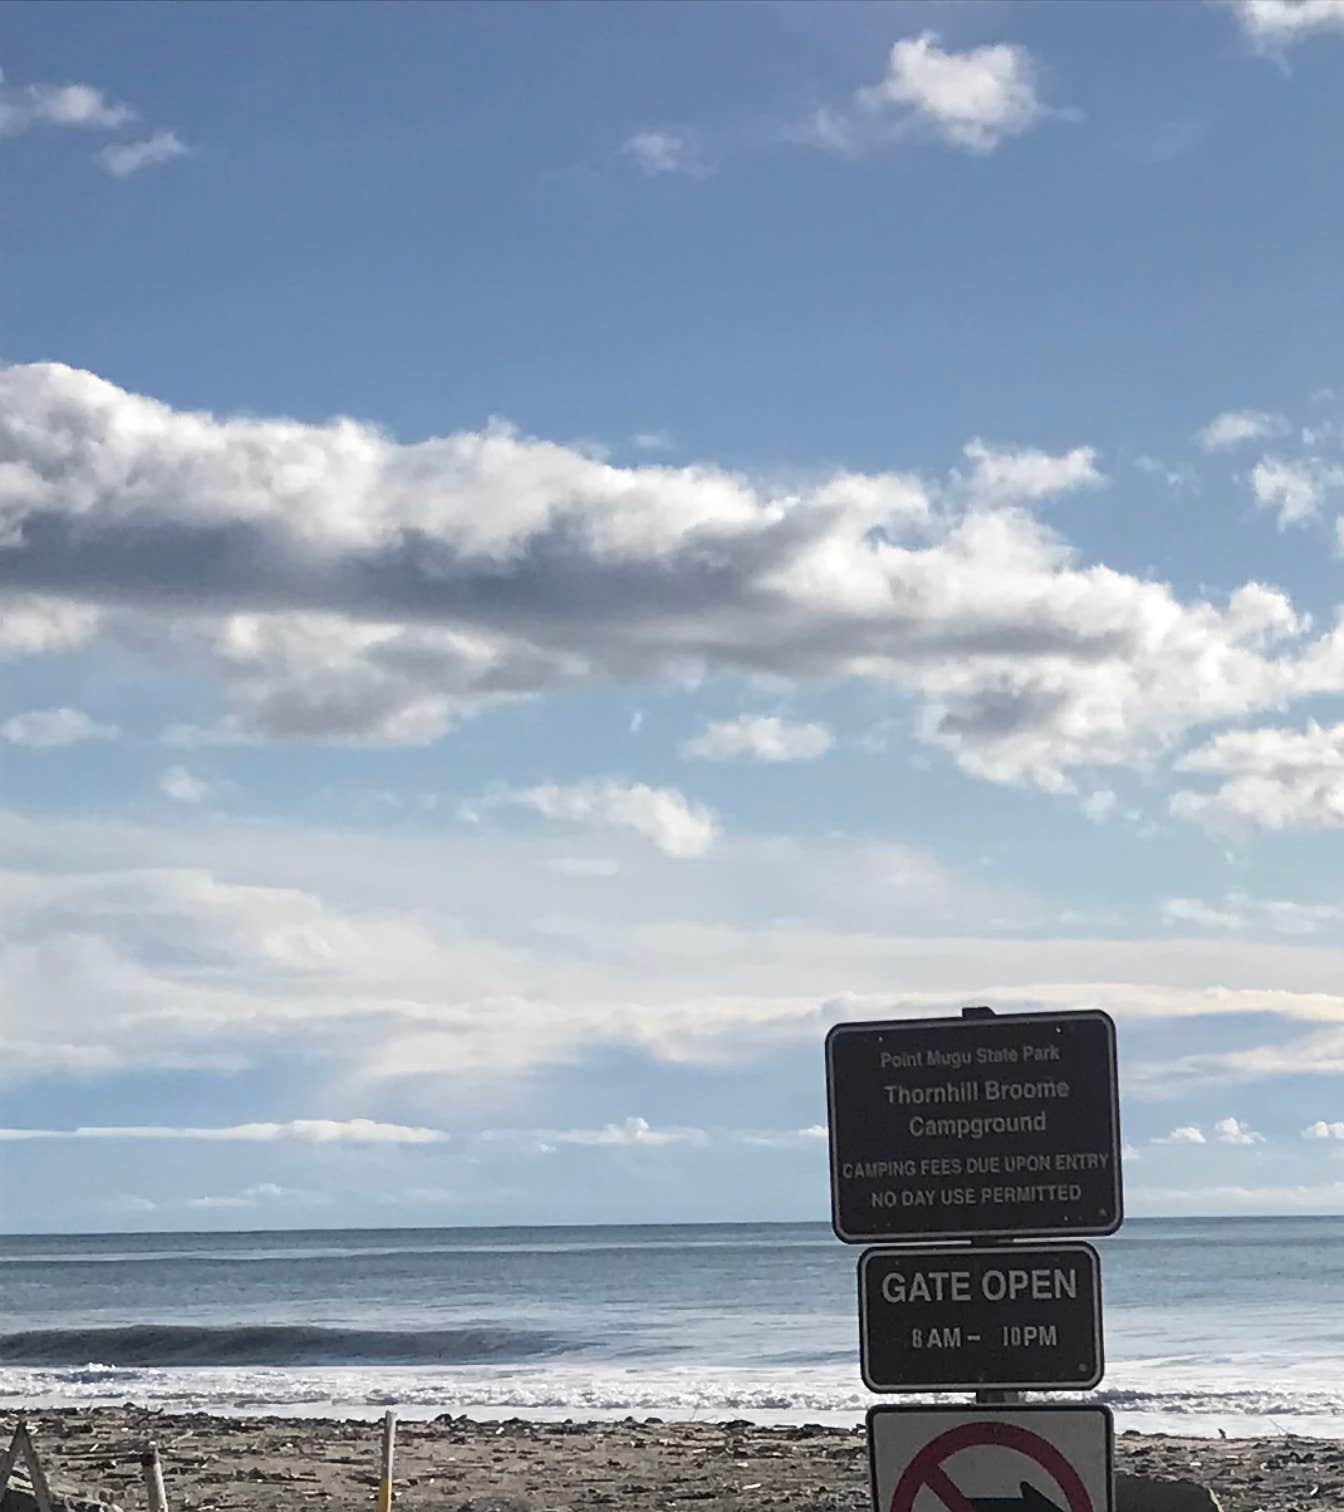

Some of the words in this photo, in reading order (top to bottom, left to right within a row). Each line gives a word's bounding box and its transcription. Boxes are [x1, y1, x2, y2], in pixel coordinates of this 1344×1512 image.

[880, 1050, 922, 1069] Point
[927, 1048, 972, 1070] Mugu
[976, 1047, 1019, 1065] State
[1023, 1044, 1060, 1062] Park
[885, 1081, 979, 1105] Thornhill
[985, 1079, 1070, 1101] Broome
[908, 1111, 1048, 1139] Campground
[842, 1159, 917, 1179] CAMPING
[921, 1157, 962, 1176] FEES
[966, 1155, 999, 1174] DUE
[1004, 1154, 1051, 1173] UPON
[1055, 1152, 1110, 1171] ENTRY
[871, 1192, 897, 1209] NO
[901, 1189, 938, 1207] DAY
[941, 1188, 976, 1206] USE
[980, 1184, 1082, 1204] PERMITTED
[881, 1270, 972, 1304] GATE
[981, 1268, 1078, 1302] OPEN
